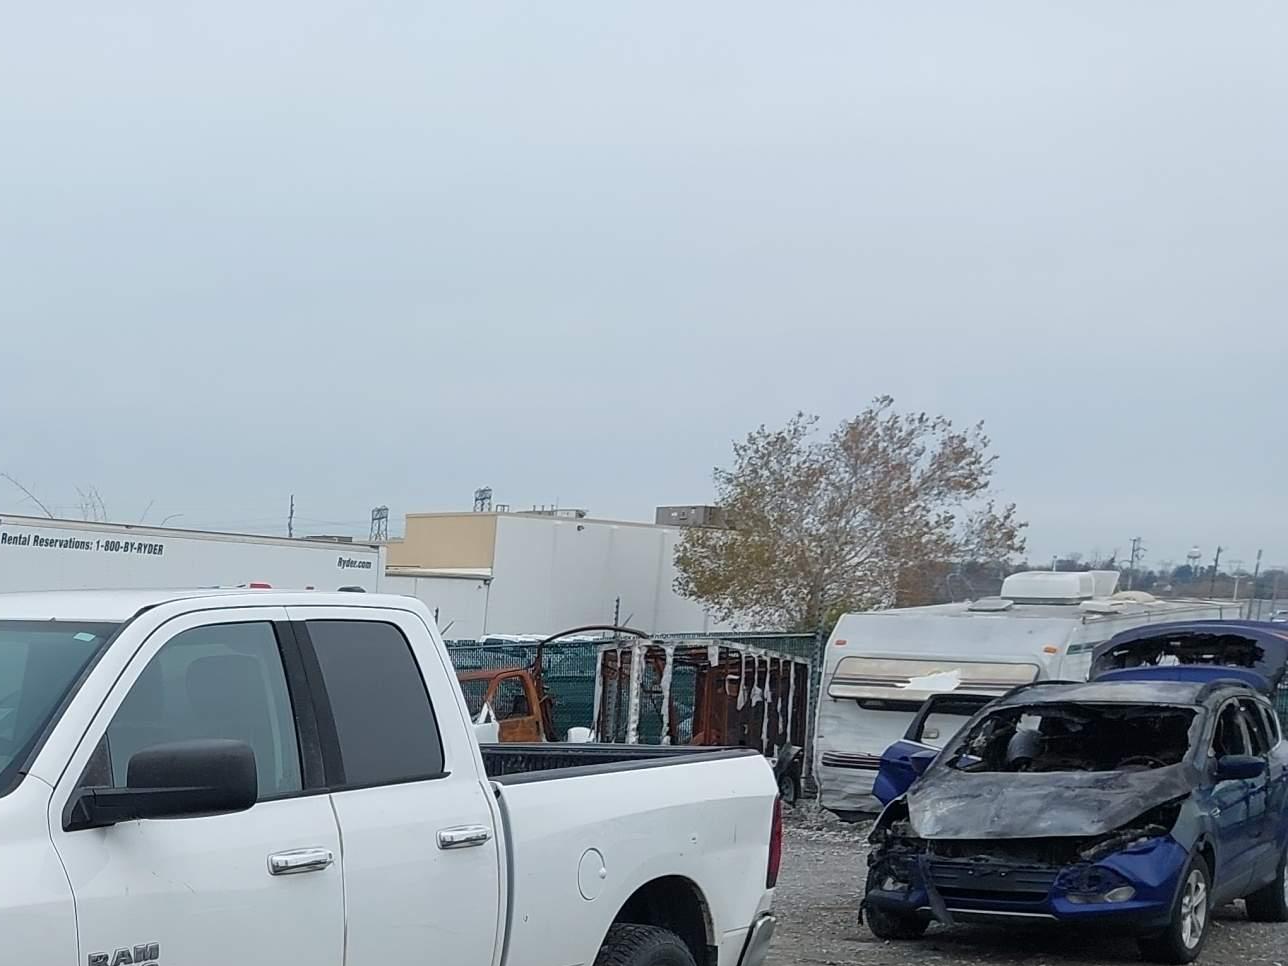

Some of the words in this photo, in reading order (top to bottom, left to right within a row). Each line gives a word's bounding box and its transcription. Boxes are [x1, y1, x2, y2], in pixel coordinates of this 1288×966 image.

[0, 532, 31, 546] Rental
[32, 534, 94, 551] Reservations:
[95, 539, 164, 556] 1-800-BY-RYDER
[337, 556, 372, 570] Ryder.com
